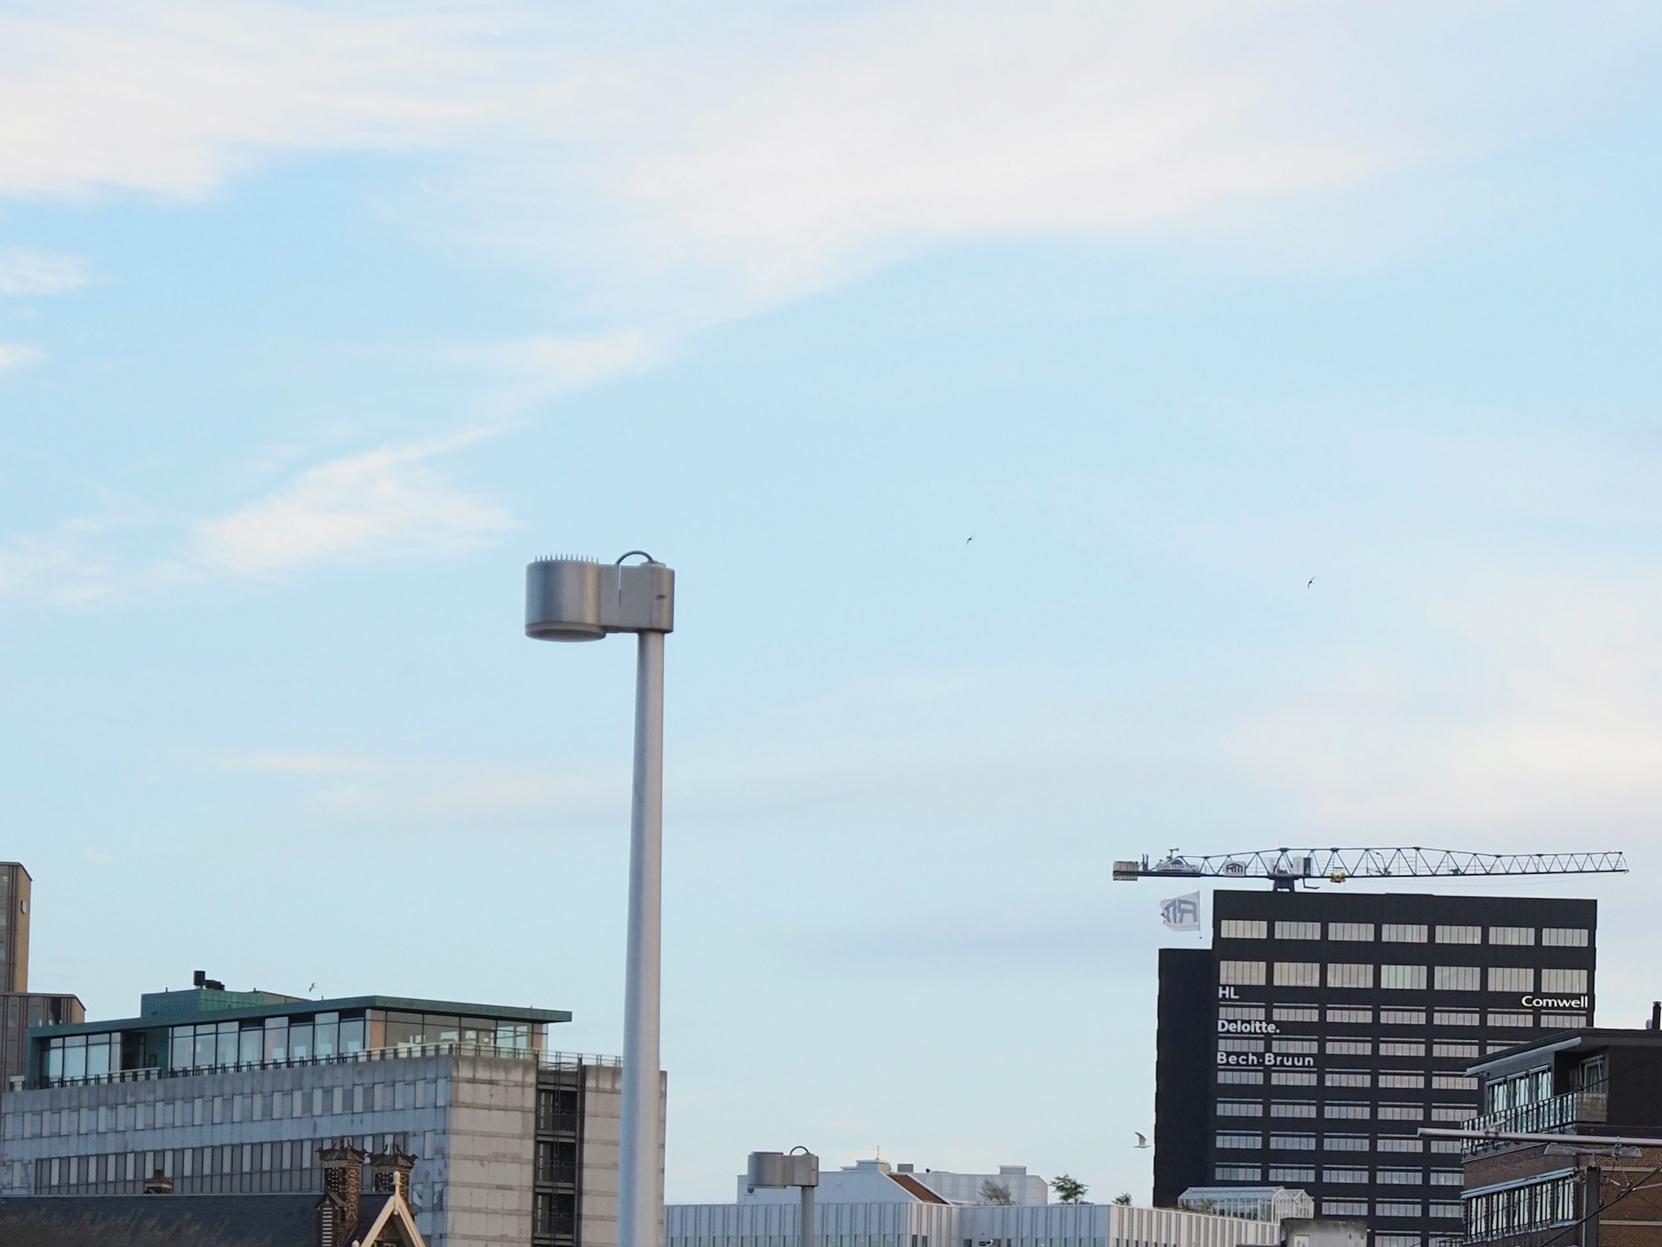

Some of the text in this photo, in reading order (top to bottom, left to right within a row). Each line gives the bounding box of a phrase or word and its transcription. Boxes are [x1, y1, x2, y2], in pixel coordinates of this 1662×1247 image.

[1218, 985, 1240, 999] HL
[1521, 995, 1589, 1009] Comwell
[1217, 1019, 1281, 1033] Deloitte.
